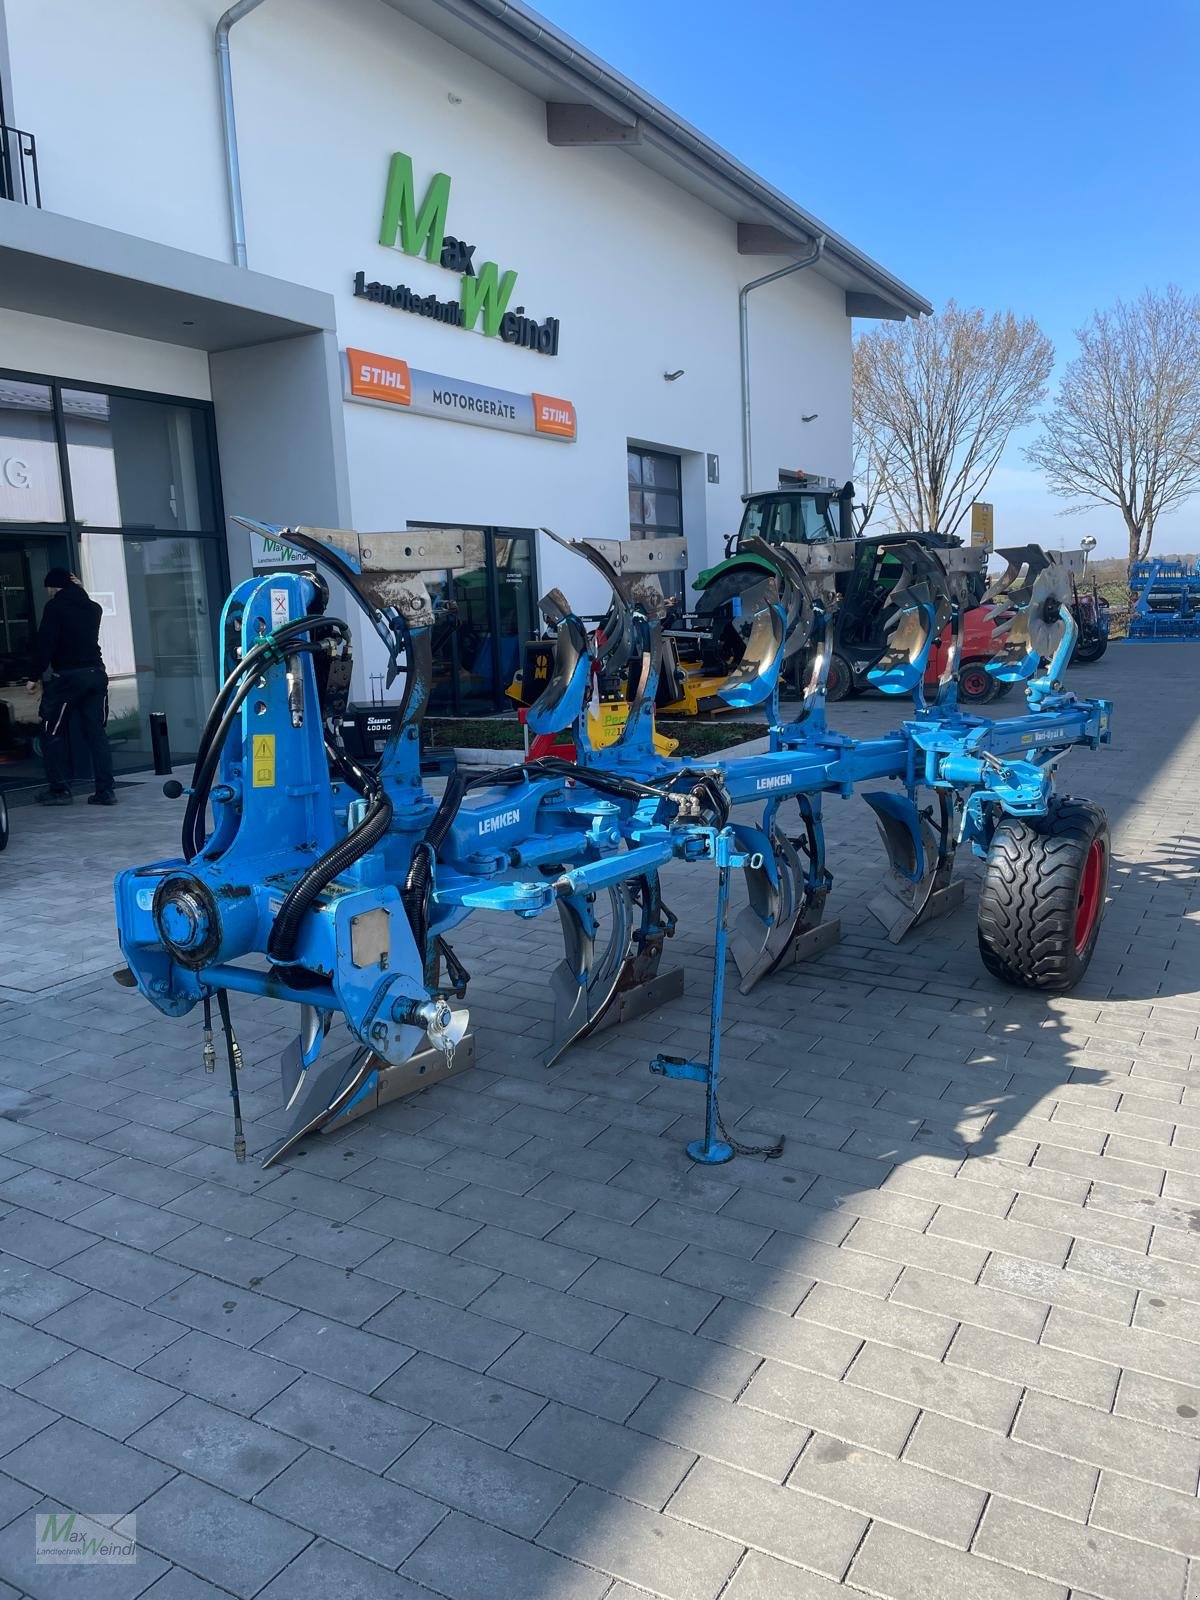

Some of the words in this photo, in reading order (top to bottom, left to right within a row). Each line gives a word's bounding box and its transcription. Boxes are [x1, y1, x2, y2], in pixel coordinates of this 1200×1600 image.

[379, 152, 476, 276] Max
[354, 271, 465, 327] Landtechnik
[460, 261, 560, 356] Weindl
[360, 365, 406, 390] STIHL
[432, 390, 516, 419] MOTORGERÄTE
[542, 407, 572, 425] STIHL
[0, 457, 30, 489] G
[756, 773, 792, 791] LEMKEN
[478, 808, 520, 836] LEMKEN
